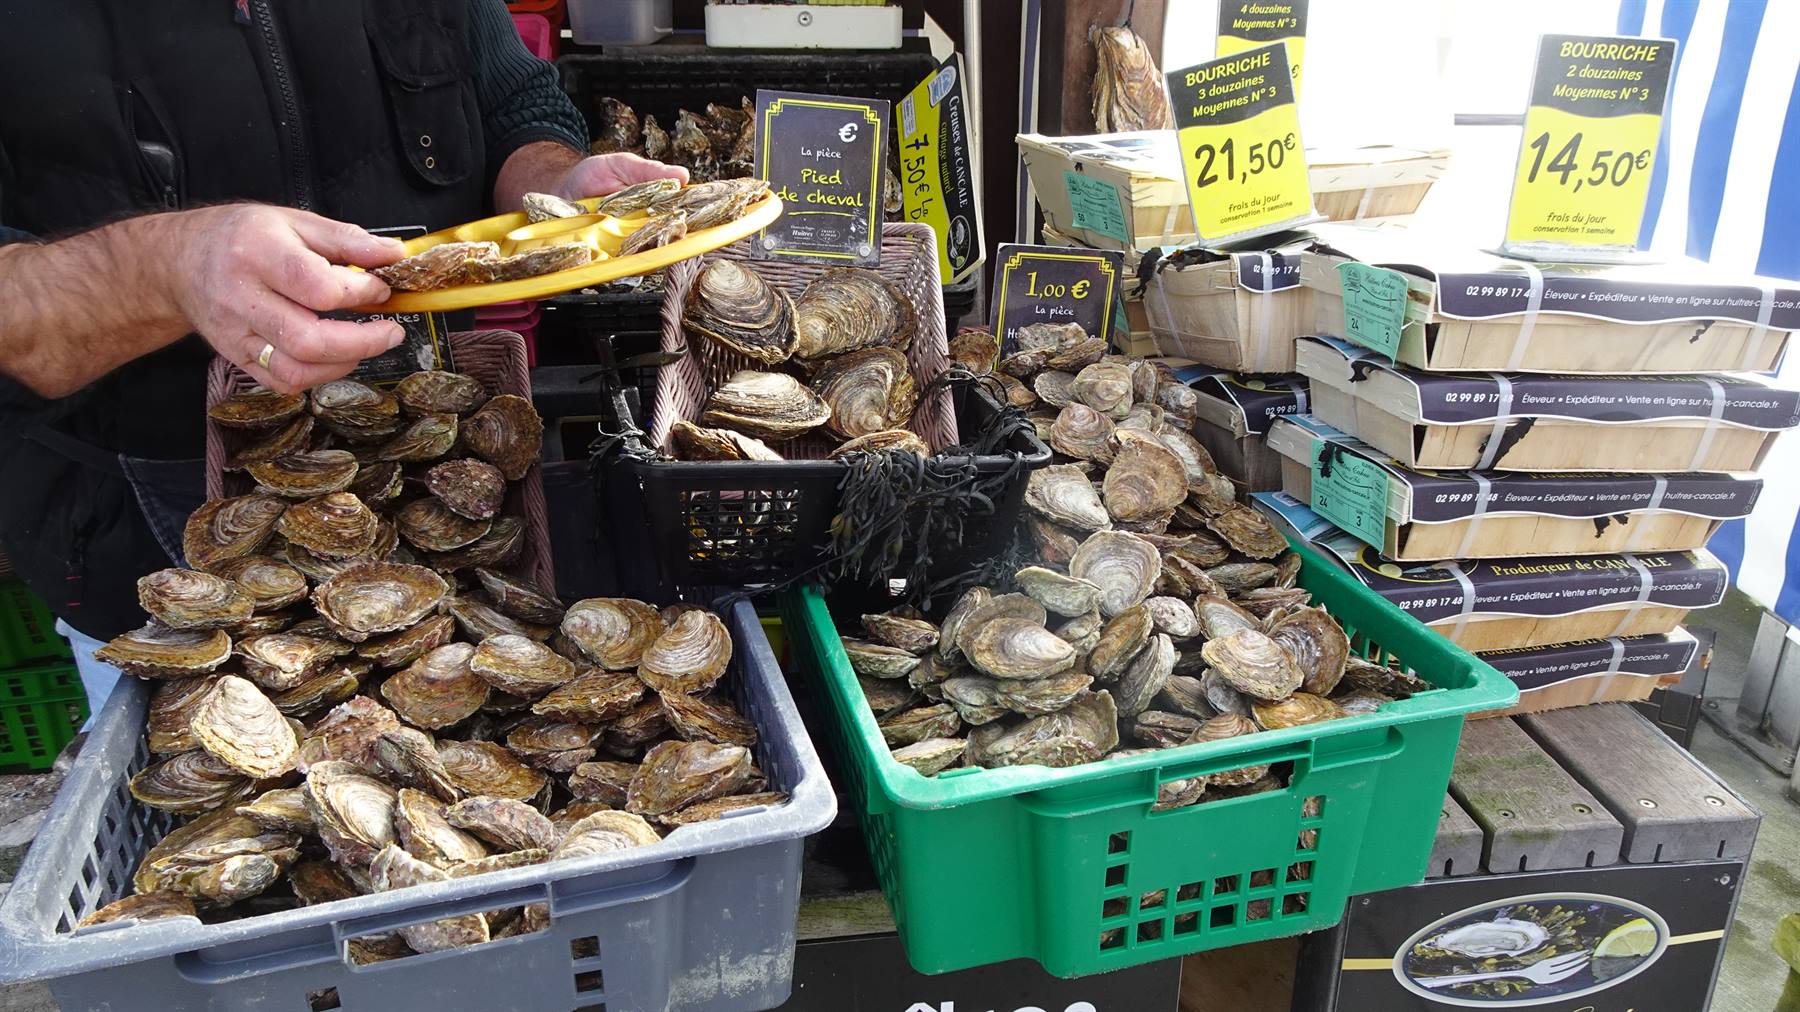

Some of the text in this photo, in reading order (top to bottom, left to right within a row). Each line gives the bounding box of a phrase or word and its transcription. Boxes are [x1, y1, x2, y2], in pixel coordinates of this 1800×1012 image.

[1241, 3, 1292, 14] 4 douzaines
[1232, 17, 1297, 31] Moyennes N° 3
[1559, 41, 1659, 62] BOURRICHE
[1185, 52, 1271, 87] BOURRICHE
[1566, 64, 1643, 81] 2 douzaines
[1198, 74, 1265, 99] 3 douzaines
[1552, 84, 1649, 101] Moyennes N° 3
[1192, 86, 1277, 118] Moyennes N° 3
[838, 122, 859, 142] €
[801, 147, 842, 162] La pièce
[939, 121, 954, 194] captage naturel
[949, 95, 968, 208] Creuses de CANCALE
[801, 168, 842, 185] Pied
[776, 185, 864, 207] de cheval
[1228, 194, 1281, 213] frais du jour
[1220, 209, 1261, 224] conservation
[1267, 201, 1293, 213] semaine
[1547, 212, 1606, 225] frais du jour
[1533, 224, 1580, 234] conservation
[1586, 226, 1615, 235] semaine
[1283, 265, 1293, 274] 17
[1024, 271, 1091, 300] 1,00 €
[1466, 286, 1479, 296] 02
[1481, 287, 1494, 296] 99
[1495, 287, 1508, 297] 89
[1510, 288, 1522, 298] 17
[1544, 289, 1579, 301] Éleveur
[1588, 291, 1638, 304] Expéditeur
[1648, 294, 1674, 304] Vente
[1675, 297, 1687, 305] en
[1689, 295, 1711, 307] ligne
[1712, 298, 1725, 306] sur
[1035, 305, 1074, 319] La pièce
[1445, 393, 1457, 402] 02
[1459, 393, 1471, 402] 99
[1473, 393, 1486, 403] 89
[1488, 393, 1499, 403] 17
[1522, 393, 1555, 404] Éleveur
[1565, 395, 1615, 405] Expéditeur
[1625, 395, 1651, 404] Vente
[1666, 396, 1687, 406] ligne
[1688, 398, 1701, 406] sur
[1702, 398, 1779, 409] hues-cancale.fr
[1265, 405, 1297, 416] 02 99 89
[1319, 495, 1328, 508] 24
[1435, 494, 1447, 503] 02
[1448, 494, 1460, 502] 99
[1461, 493, 1472, 502] 89
[1504, 492, 1536, 502] Éleveur
[1544, 493, 1588, 503] Expéditeur
[1596, 493, 1619, 501] Vente
[1632, 493, 1651, 502] ligne
[1490, 562, 1572, 577] Producteur
[1575, 560, 1591, 571] de
[1399, 582, 1702, 610] 02 99 89 17 48 leveur Expéditeur Vente en ligne sur hues-cancale.fr
[1535, 664, 1557, 675] Vente
[1558, 664, 1569, 672] en
[1570, 661, 1588, 672] ligne
[1589, 659, 1601, 667] sur
